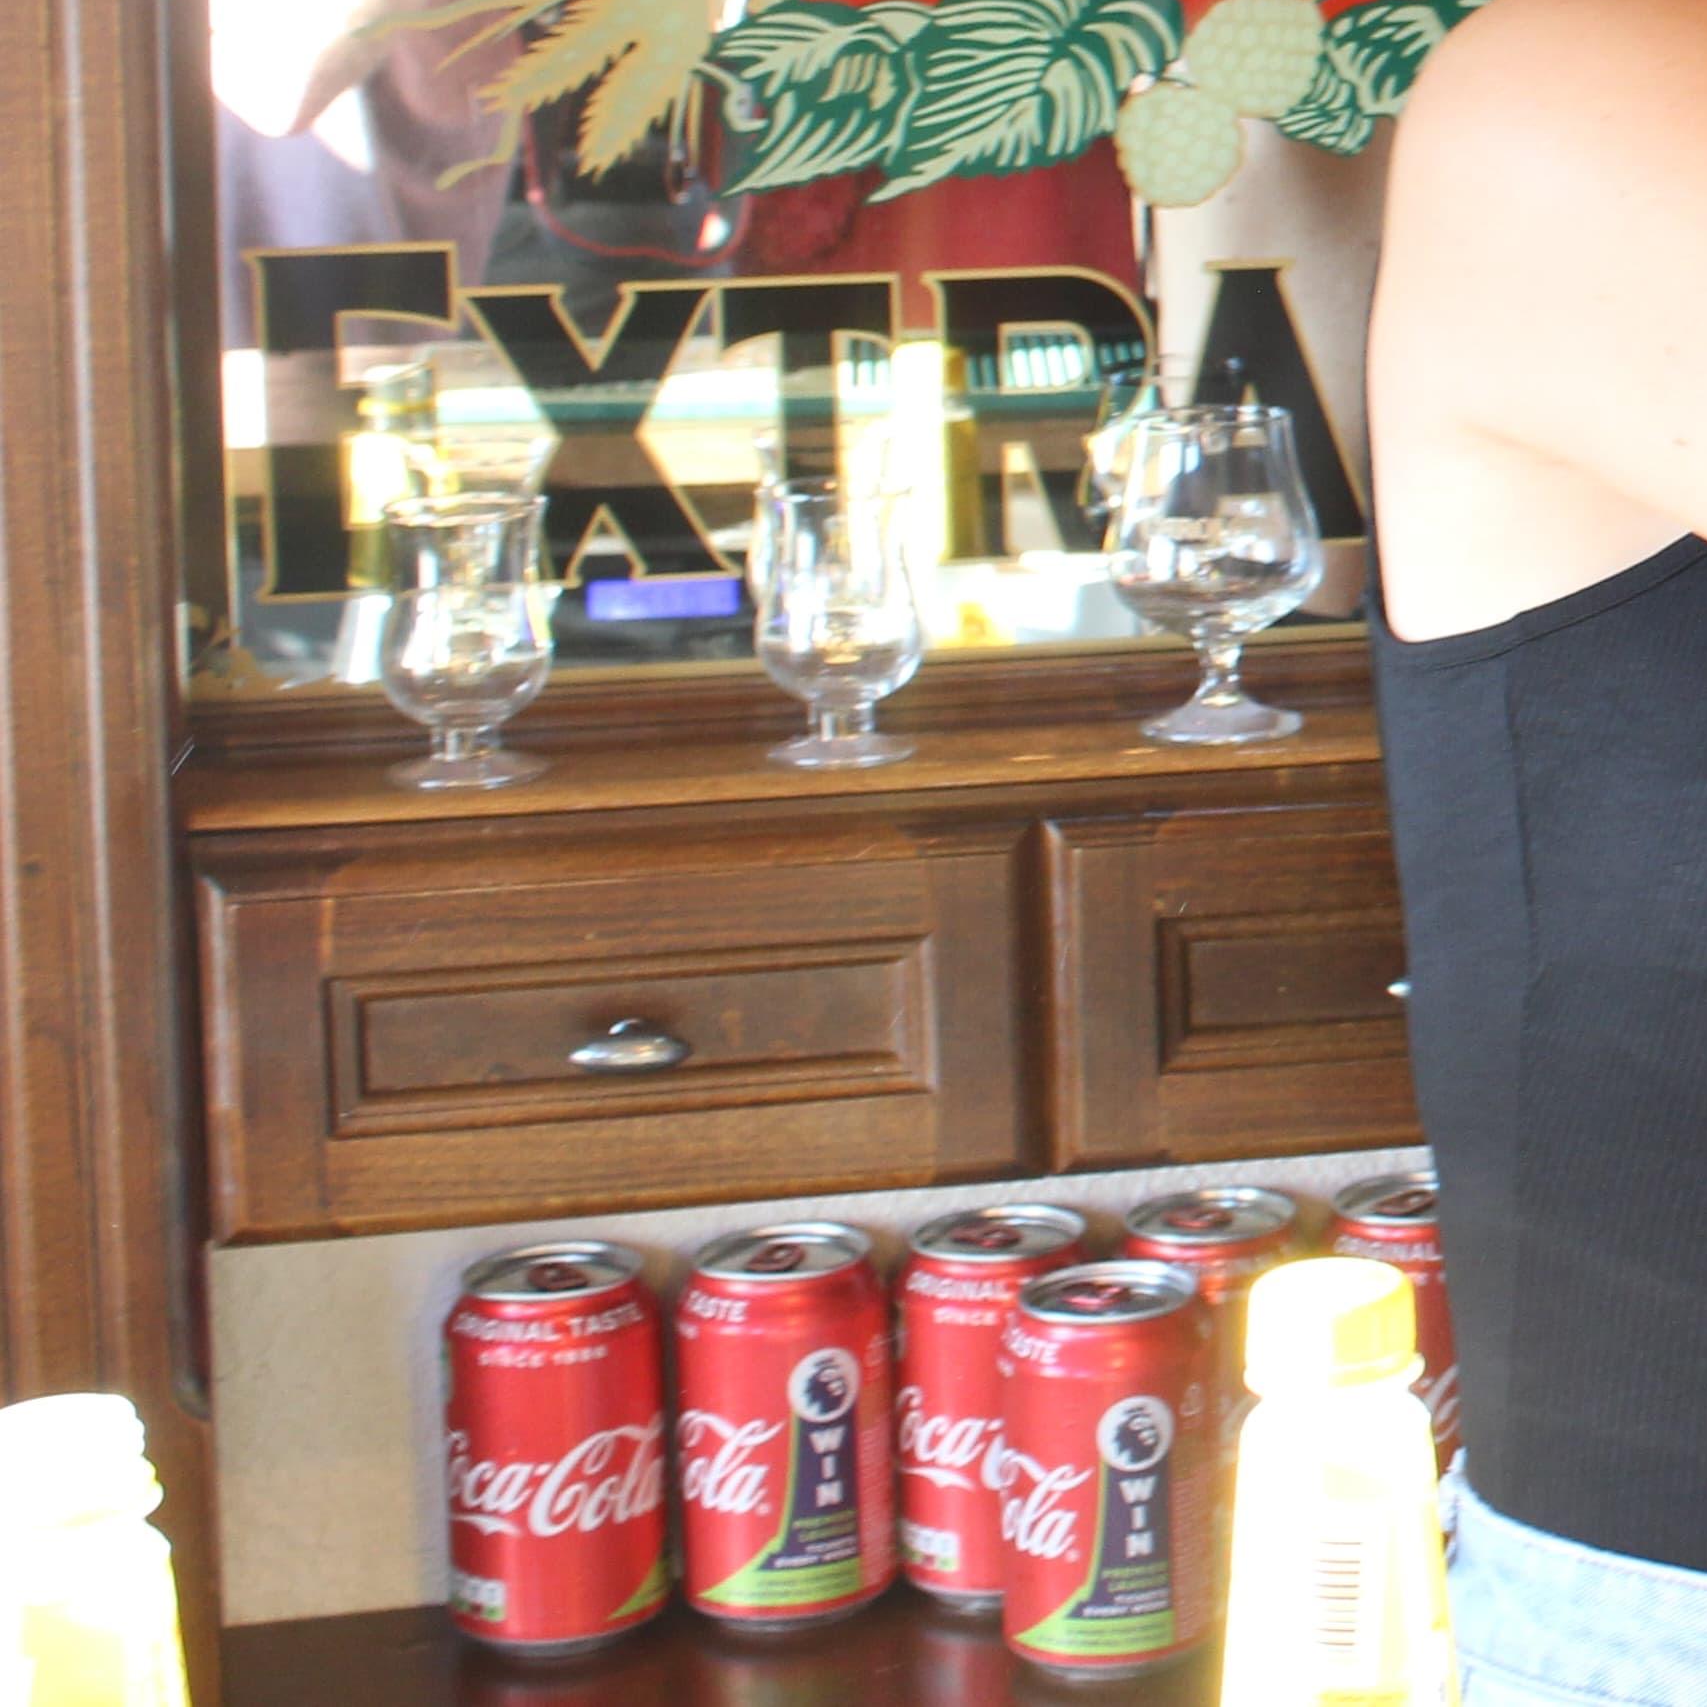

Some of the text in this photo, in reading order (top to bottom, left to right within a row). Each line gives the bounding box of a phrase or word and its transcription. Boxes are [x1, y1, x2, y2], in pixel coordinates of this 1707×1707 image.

[244, 239, 1367, 603] EXTRA
[565, 1300, 645, 1338] TASTE
[1118, 1476, 1158, 1559] WIN
